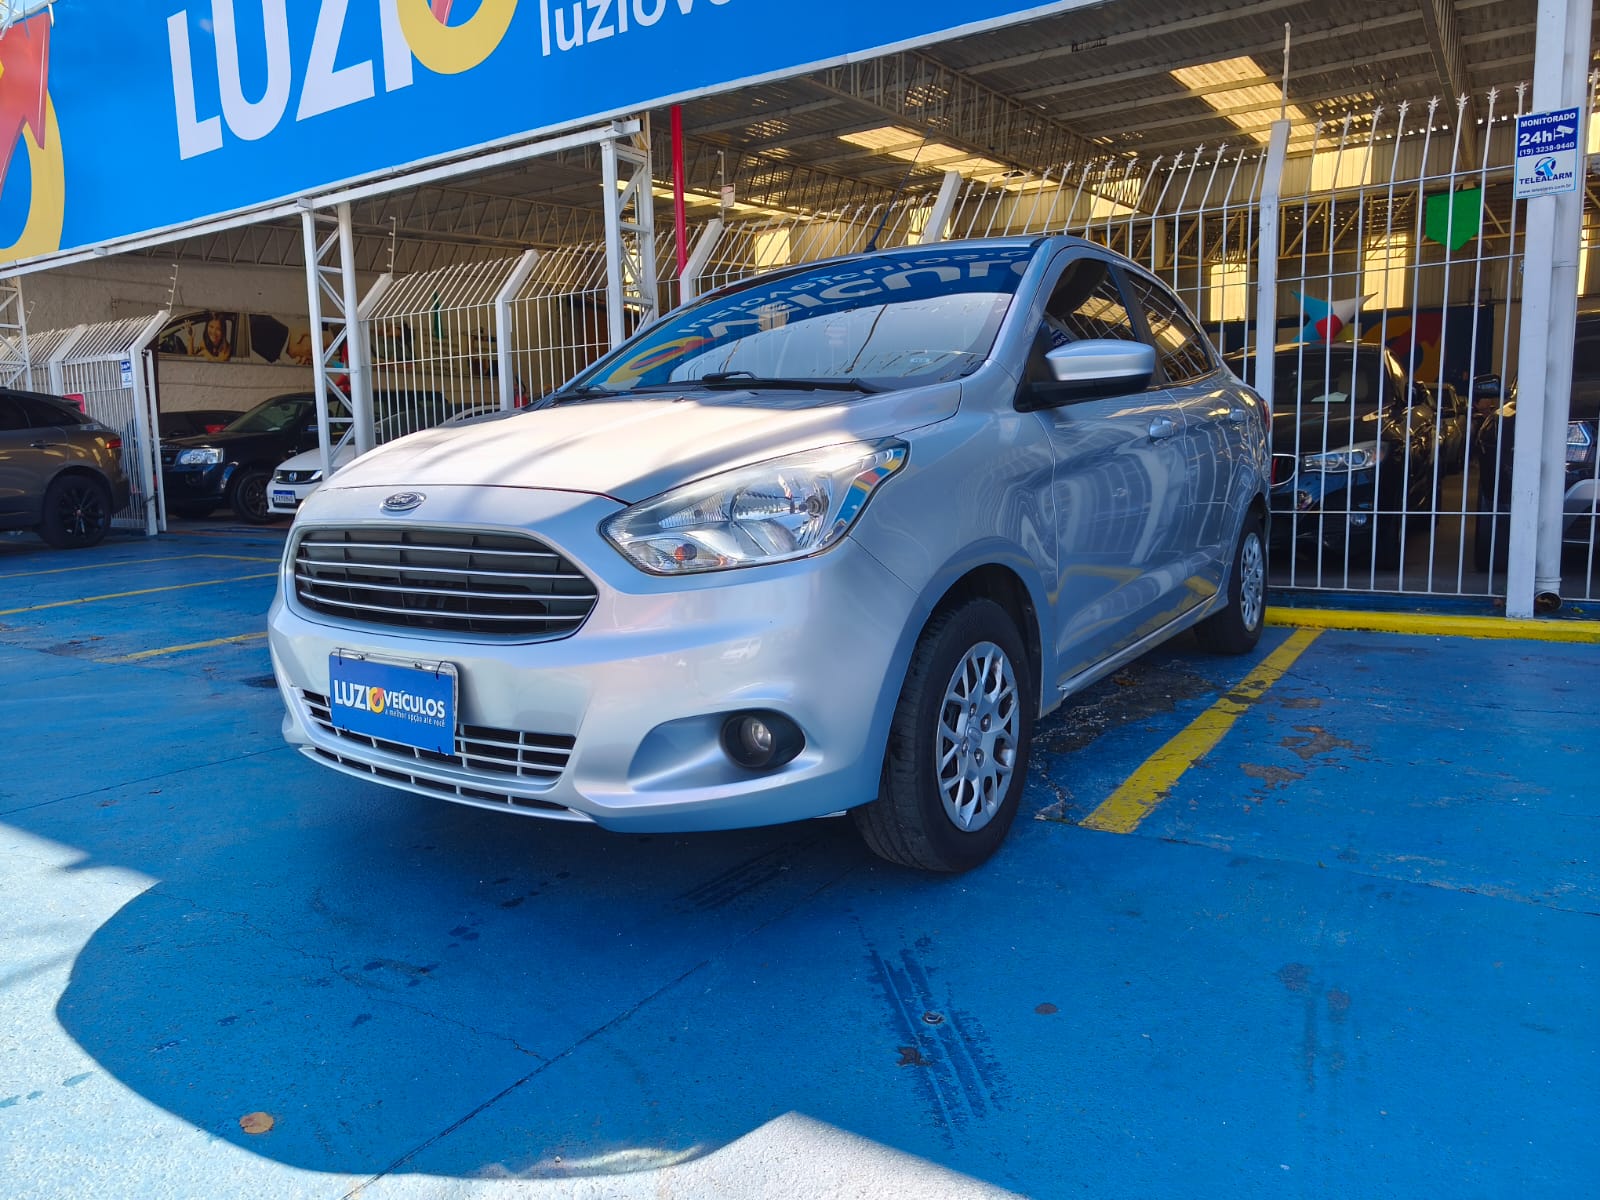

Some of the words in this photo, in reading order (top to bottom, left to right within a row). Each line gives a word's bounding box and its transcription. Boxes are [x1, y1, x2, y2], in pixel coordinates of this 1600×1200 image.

[539, 0, 732, 57] luzio
[1520, 112, 1576, 128] MONITORADO
[1519, 130, 1553, 147] 24h
[1519, 148, 1534, 157] (19)
[1519, 171, 1573, 185] TELEALARM
[333, 679, 385, 714] LUZIO
[383, 688, 446, 719] VEÍCULOS
